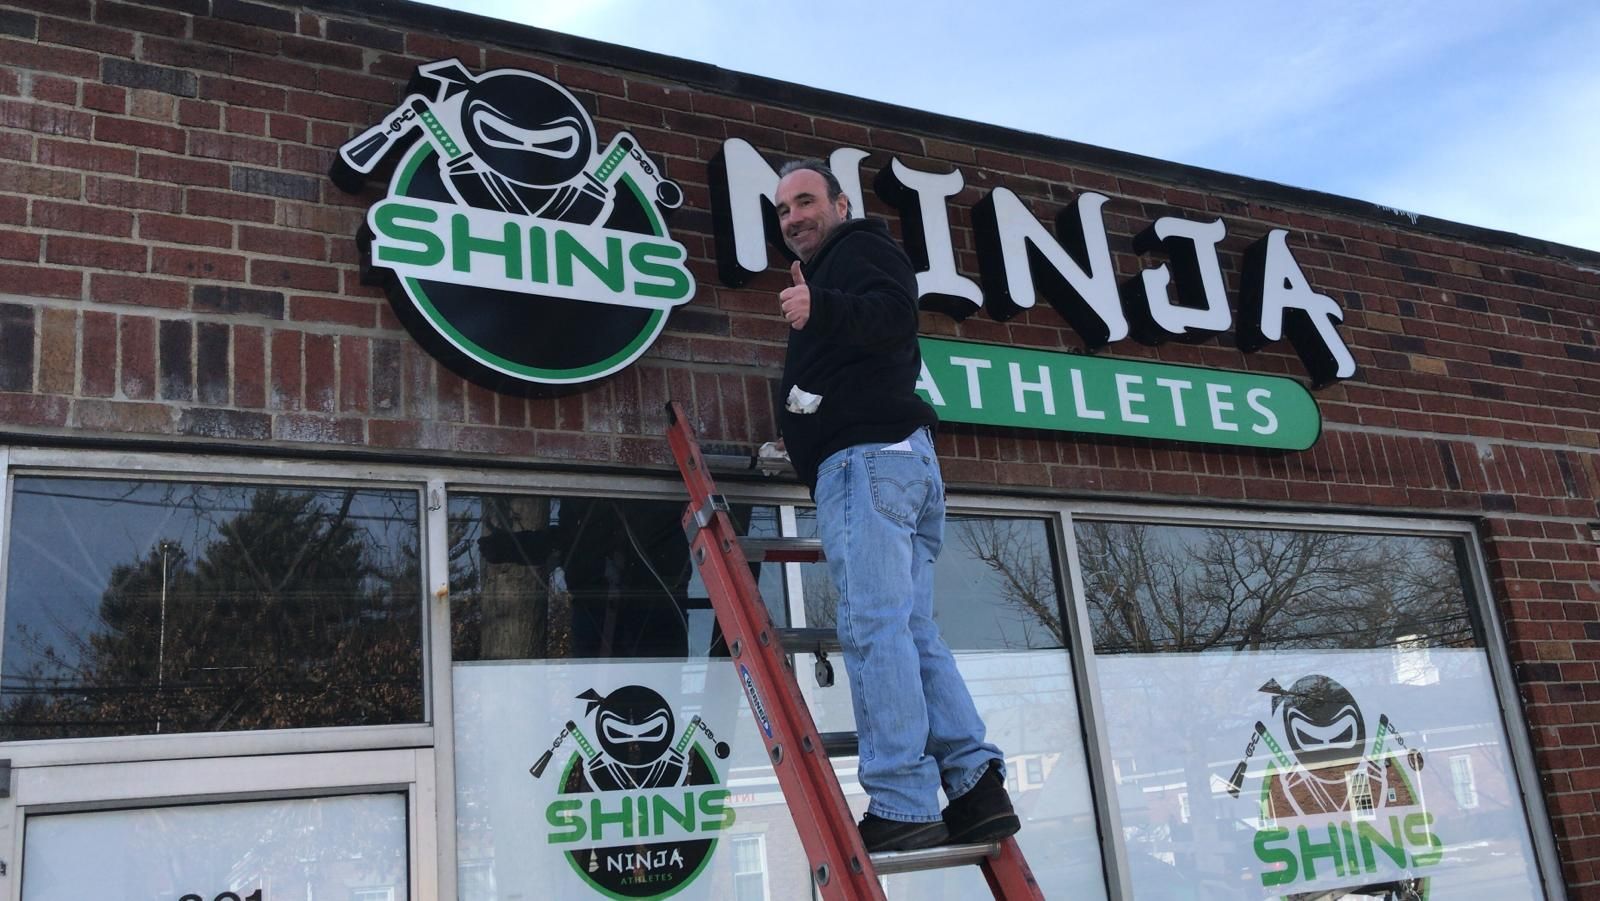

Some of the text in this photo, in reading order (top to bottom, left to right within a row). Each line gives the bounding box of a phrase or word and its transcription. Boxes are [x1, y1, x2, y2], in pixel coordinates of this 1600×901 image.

[373, 202, 691, 300] SHINS
[723, 137, 1357, 379] NINJA
[545, 789, 737, 844] SHINS
[606, 847, 684, 874] NINJA
[620, 872, 673, 885] ATHLETES
[1253, 812, 1443, 887] SHINS
